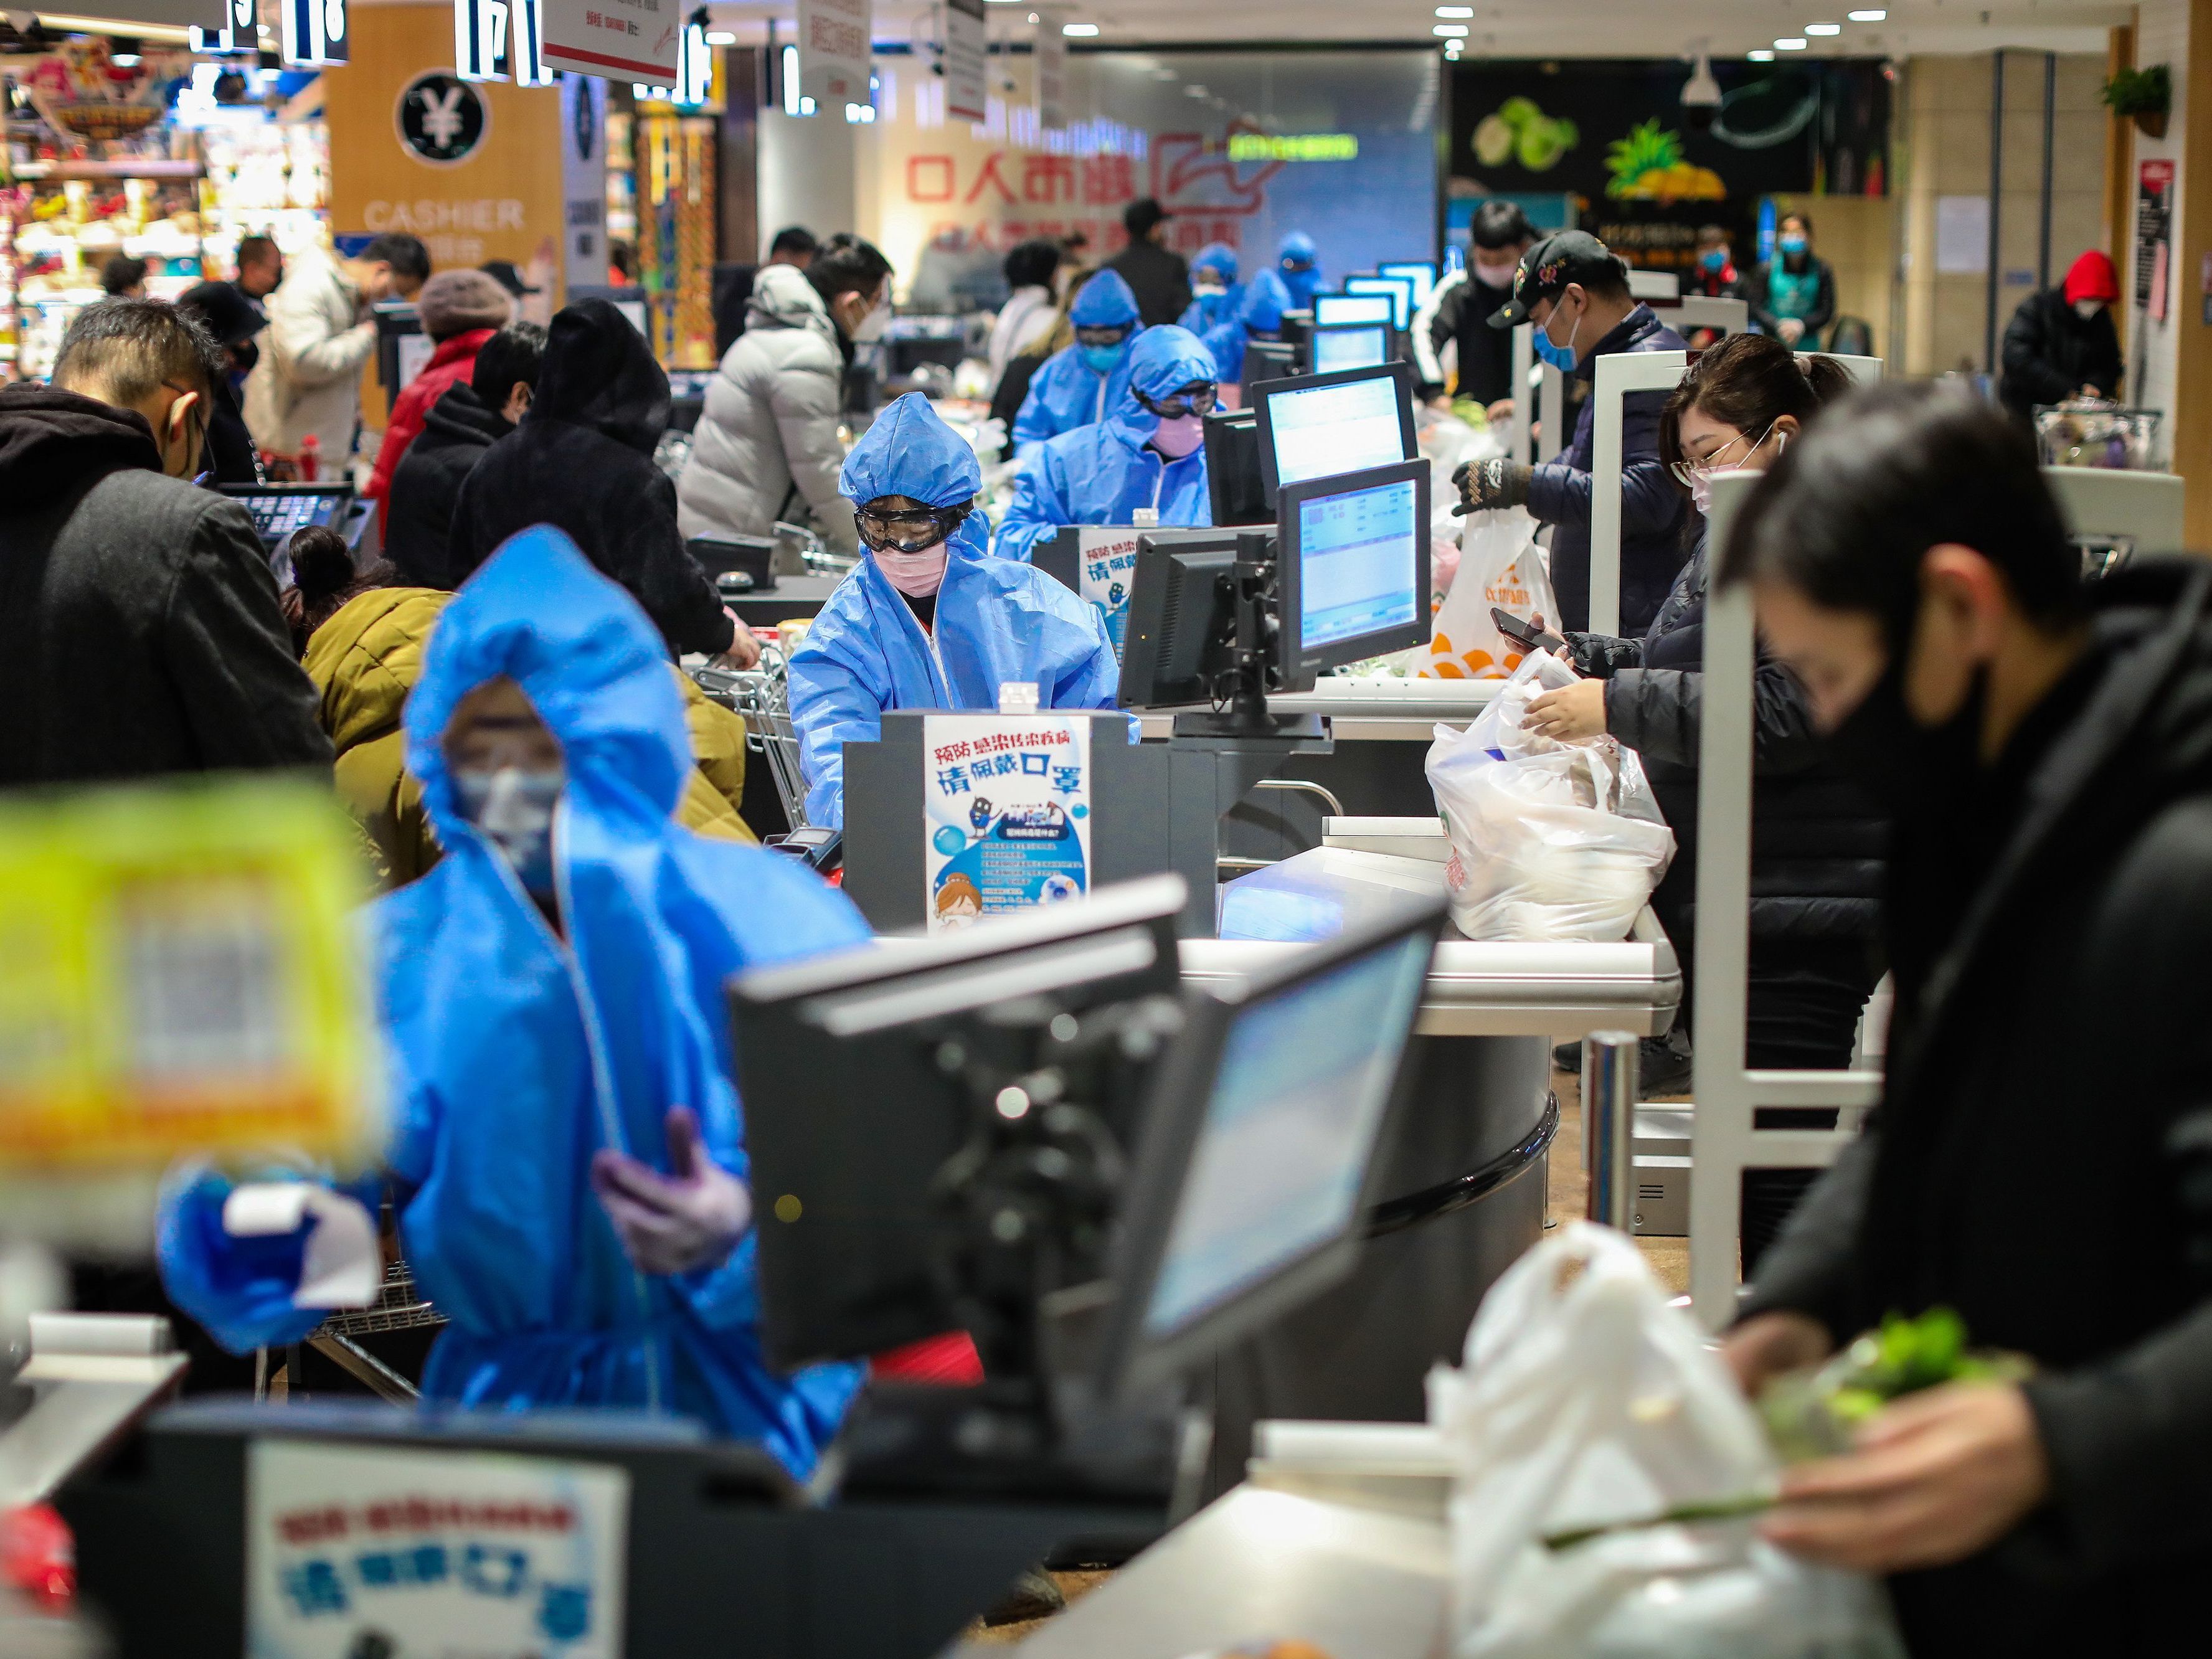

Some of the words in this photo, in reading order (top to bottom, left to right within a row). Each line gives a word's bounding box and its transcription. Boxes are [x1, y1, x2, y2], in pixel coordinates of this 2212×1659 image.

[364, 199, 525, 232] CASHIER
[936, 751, 1082, 796] 请佩戴口罩
